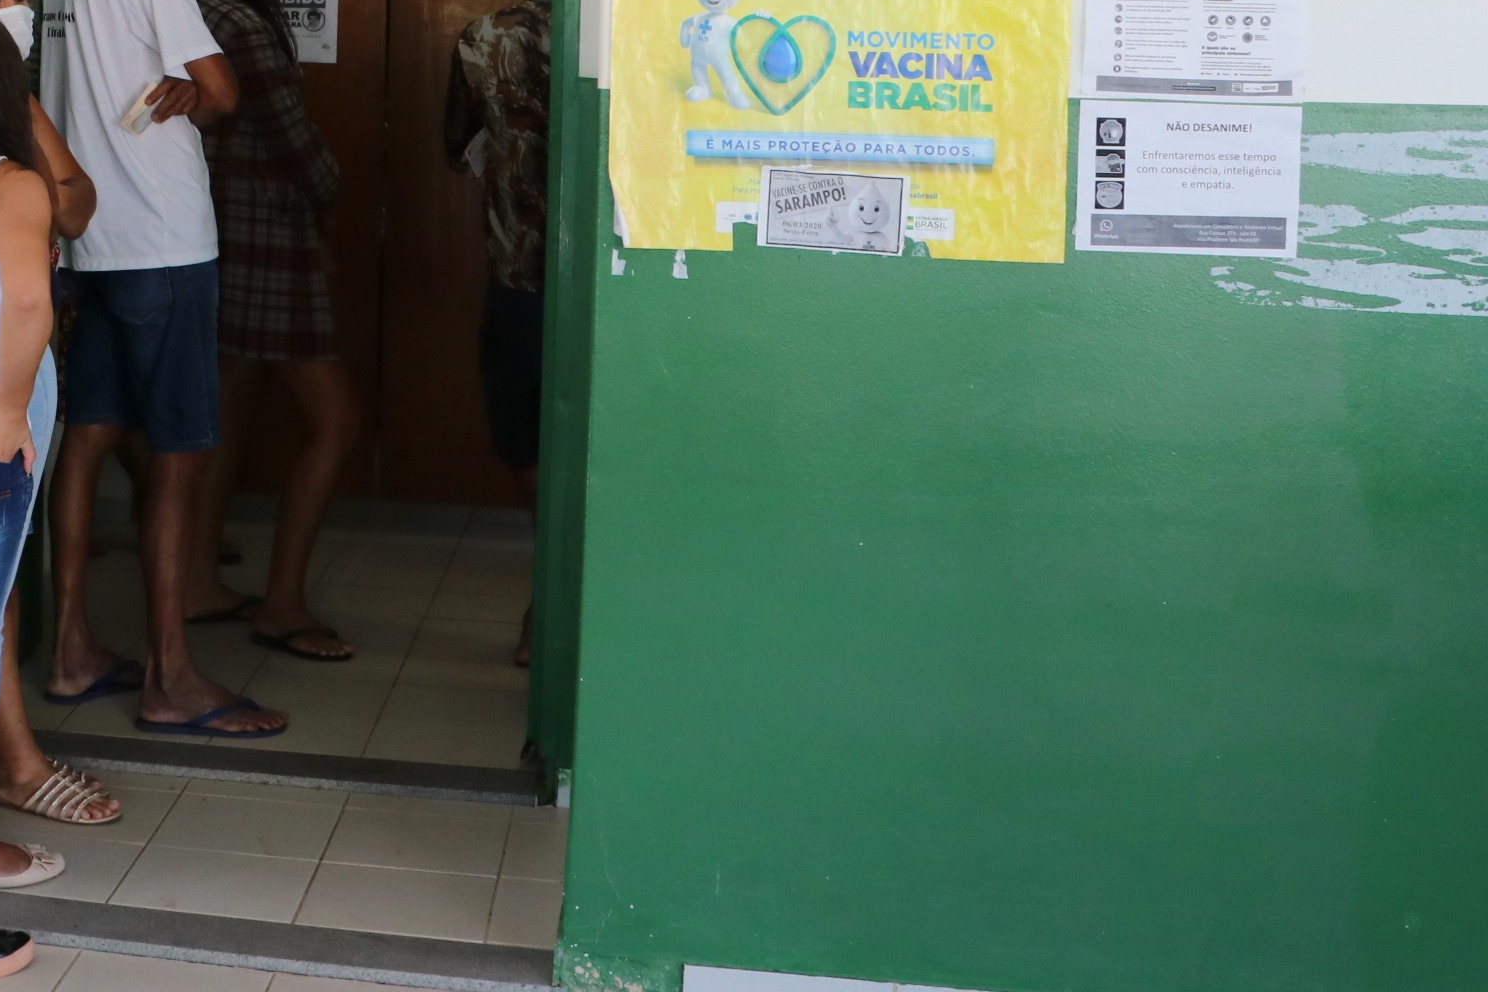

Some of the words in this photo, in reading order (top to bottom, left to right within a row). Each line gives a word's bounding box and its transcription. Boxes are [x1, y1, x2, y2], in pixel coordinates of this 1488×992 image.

[847, 30, 995, 51] MOVIMENTO
[848, 51, 993, 81] VACINA
[848, 81, 993, 113] BRASIL
[1166, 120, 1190, 132] NÃO
[1192, 122, 1253, 133] DESANIME!
[706, 137, 714, 150] É
[722, 139, 761, 151] MAIS
[768, 138, 856, 156] PROTEÇÃO
[864, 142, 907, 156] PARA
[914, 144, 976, 158] TODOS.
[1142, 151, 1216, 162] Enfrentaremos
[1218, 154, 1240, 162] esse
[1243, 153, 1277, 165] tempo
[1136, 166, 1158, 174] com
[1160, 165, 1221, 177] consciência,
[1224, 166, 1282, 178] inteligência
[772, 184, 808, 198] VACINE-SE
[808, 178, 836, 191] CONTRA
[838, 176, 844, 186] O
[1190, 180, 1234, 192] empatia.
[775, 187, 847, 214] SARAMPO!
[782, 220, 822, 230] 06/03/2020
[915, 220, 948, 230] BRASIL
